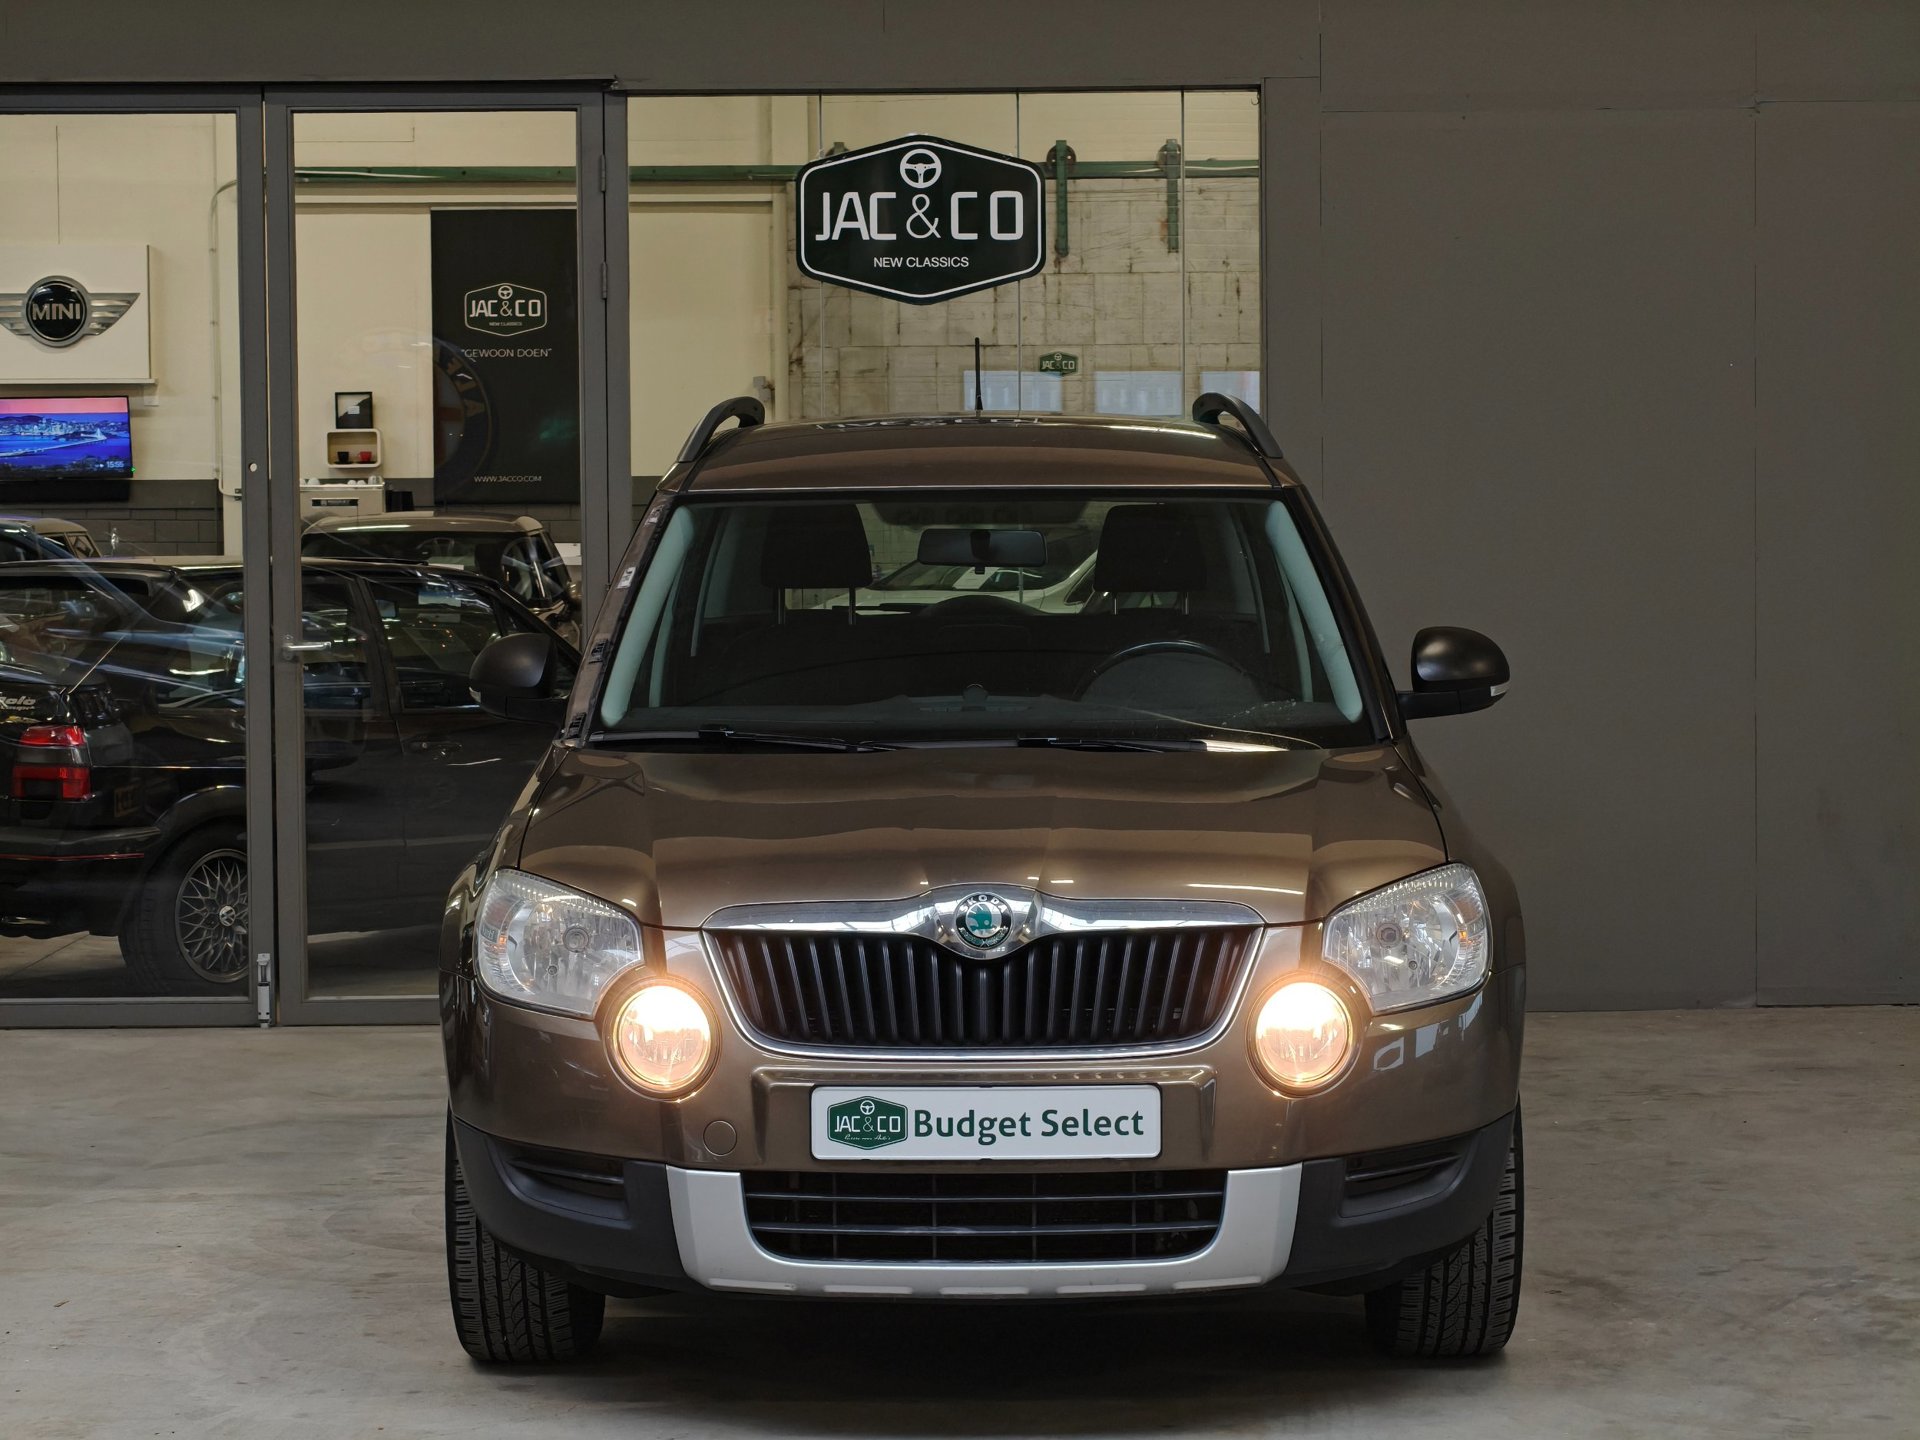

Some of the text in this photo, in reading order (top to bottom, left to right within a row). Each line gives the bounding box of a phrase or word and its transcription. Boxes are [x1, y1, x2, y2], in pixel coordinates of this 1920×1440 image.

[873, 257, 969, 268] NEW CLASSICS
[32, 303, 81, 320] MINI
[914, 1109, 1032, 1146] Budget
[1041, 1108, 1144, 1137] Select
